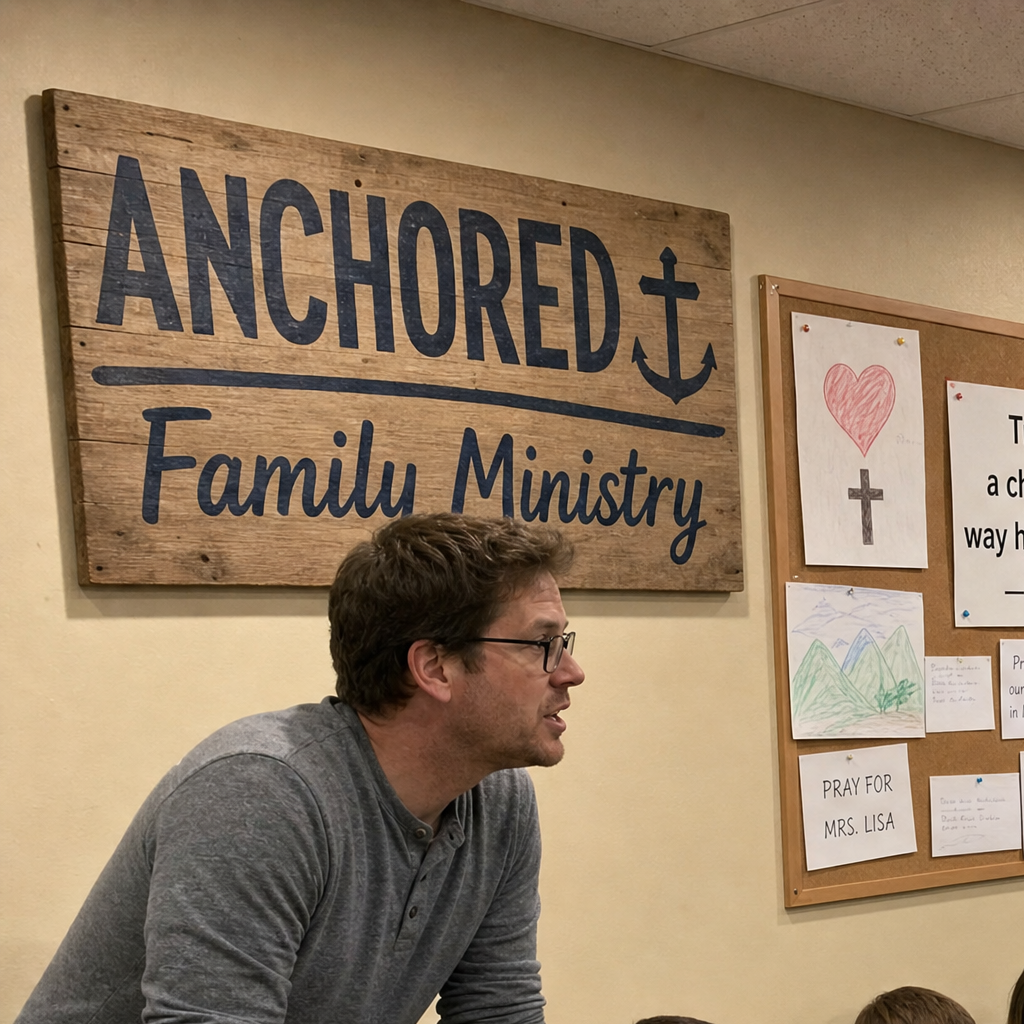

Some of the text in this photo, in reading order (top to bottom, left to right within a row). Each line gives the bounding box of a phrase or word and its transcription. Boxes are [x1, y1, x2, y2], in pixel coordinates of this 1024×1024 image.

[95, 153, 621, 375] ANCHORED
[141, 407, 708, 565] Family Ministry
[986, 474, 999, 497] a
[964, 527, 1007, 557] way
[1009, 705, 1019, 719] in
[822, 773, 893, 799] PRAY FOR
[824, 811, 895, 840] MRS. LISA
